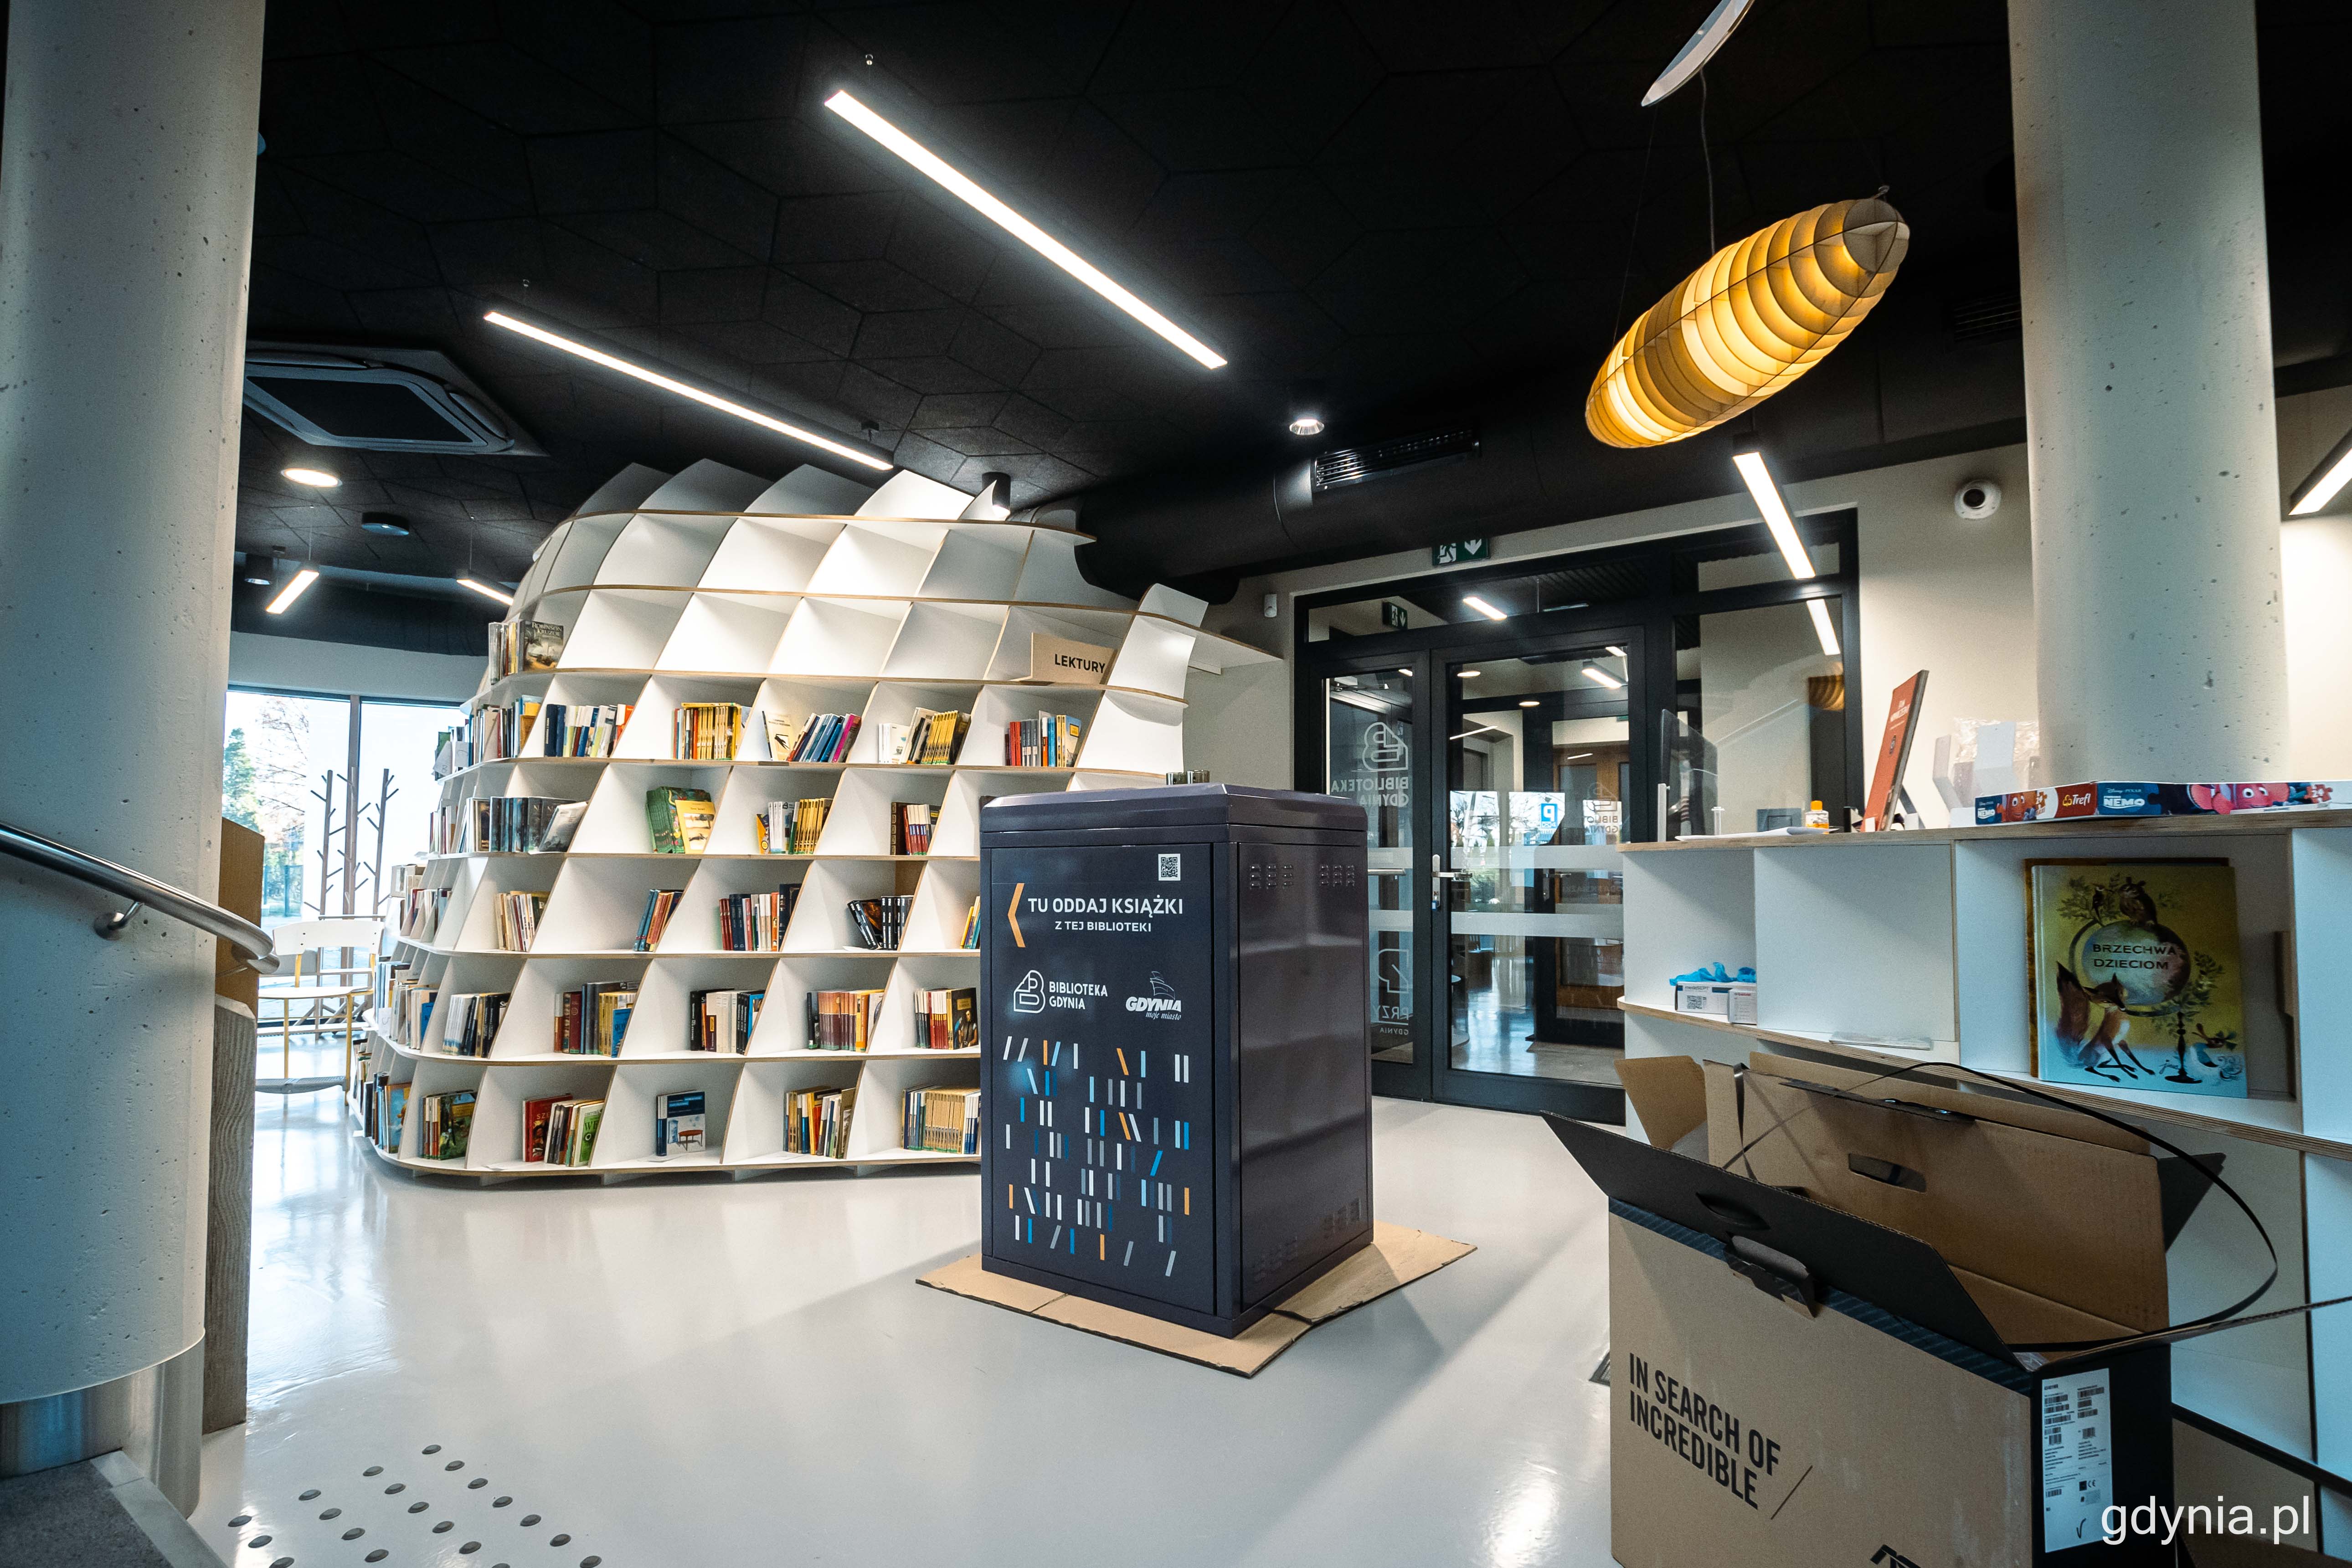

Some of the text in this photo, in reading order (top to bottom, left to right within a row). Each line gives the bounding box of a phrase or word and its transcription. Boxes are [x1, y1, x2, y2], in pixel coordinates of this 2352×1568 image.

[532, 622, 562, 632] ROBINSON
[1055, 653, 1106, 673] LEKTURY
[2072, 793, 2091, 806] Trefl
[2103, 798, 2145, 807] NEMO
[1028, 895, 1183, 918] TU ODDAJ KSIĄŻKI
[1055, 921, 1151, 932] Z TEJ BIBLIOTEKI
[2093, 944, 2177, 955] BRZECHWA
[2094, 959, 2168, 970] DZIECIOM
[1049, 982, 1108, 997] BIBLIOTEKA
[1049, 996, 1086, 1010] GDYNIA
[1126, 997, 1182, 1012] GDYNIA
[1145, 1011, 1182, 1021] moje miasto
[1629, 1352, 1781, 1476] IN SEARCH OF
[1630, 1390, 1759, 1511] INCREDIBLE
